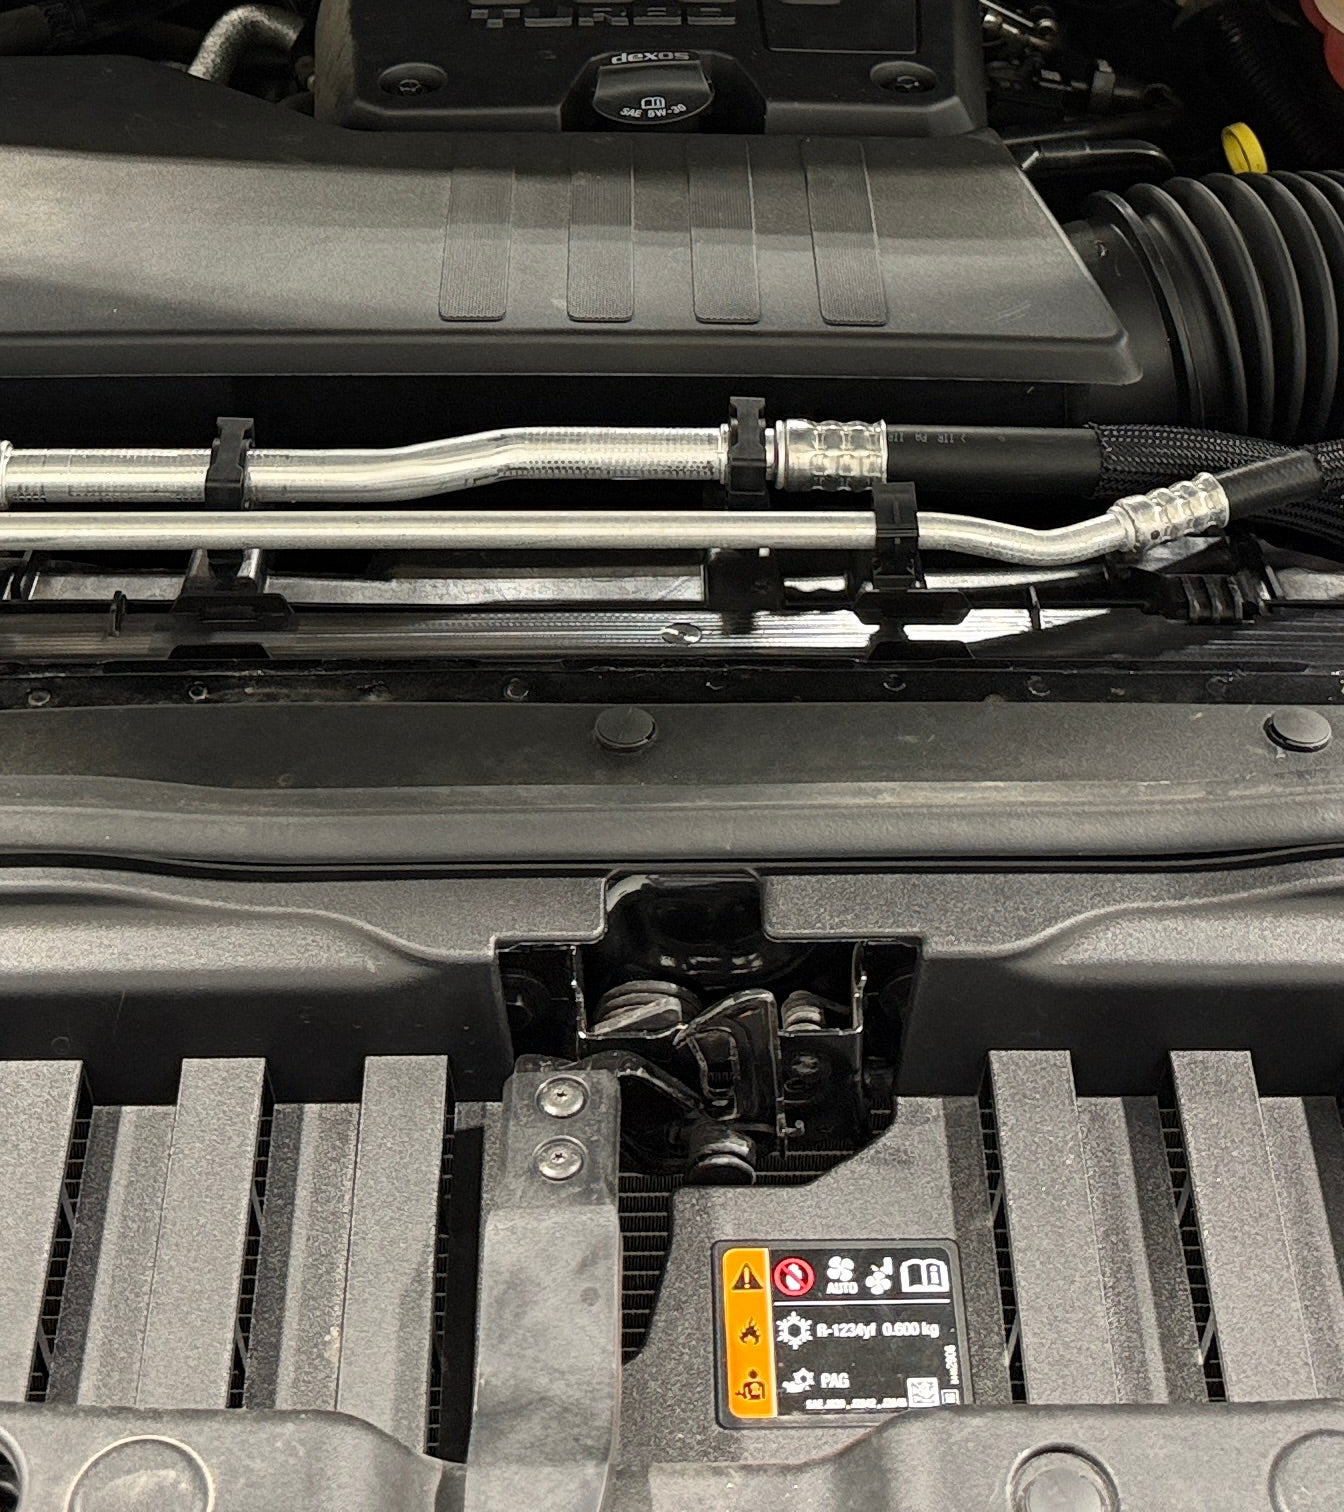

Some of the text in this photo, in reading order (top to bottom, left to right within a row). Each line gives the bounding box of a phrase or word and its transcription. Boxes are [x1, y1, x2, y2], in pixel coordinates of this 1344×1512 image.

[611, 52, 690, 65] dexos
[619, 104, 687, 118] SAE 5W-30
[826, 1281, 859, 1295] AUTO
[816, 1321, 940, 1340] R-1234yf 0.600 kg
[820, 1372, 851, 1389] PAG
